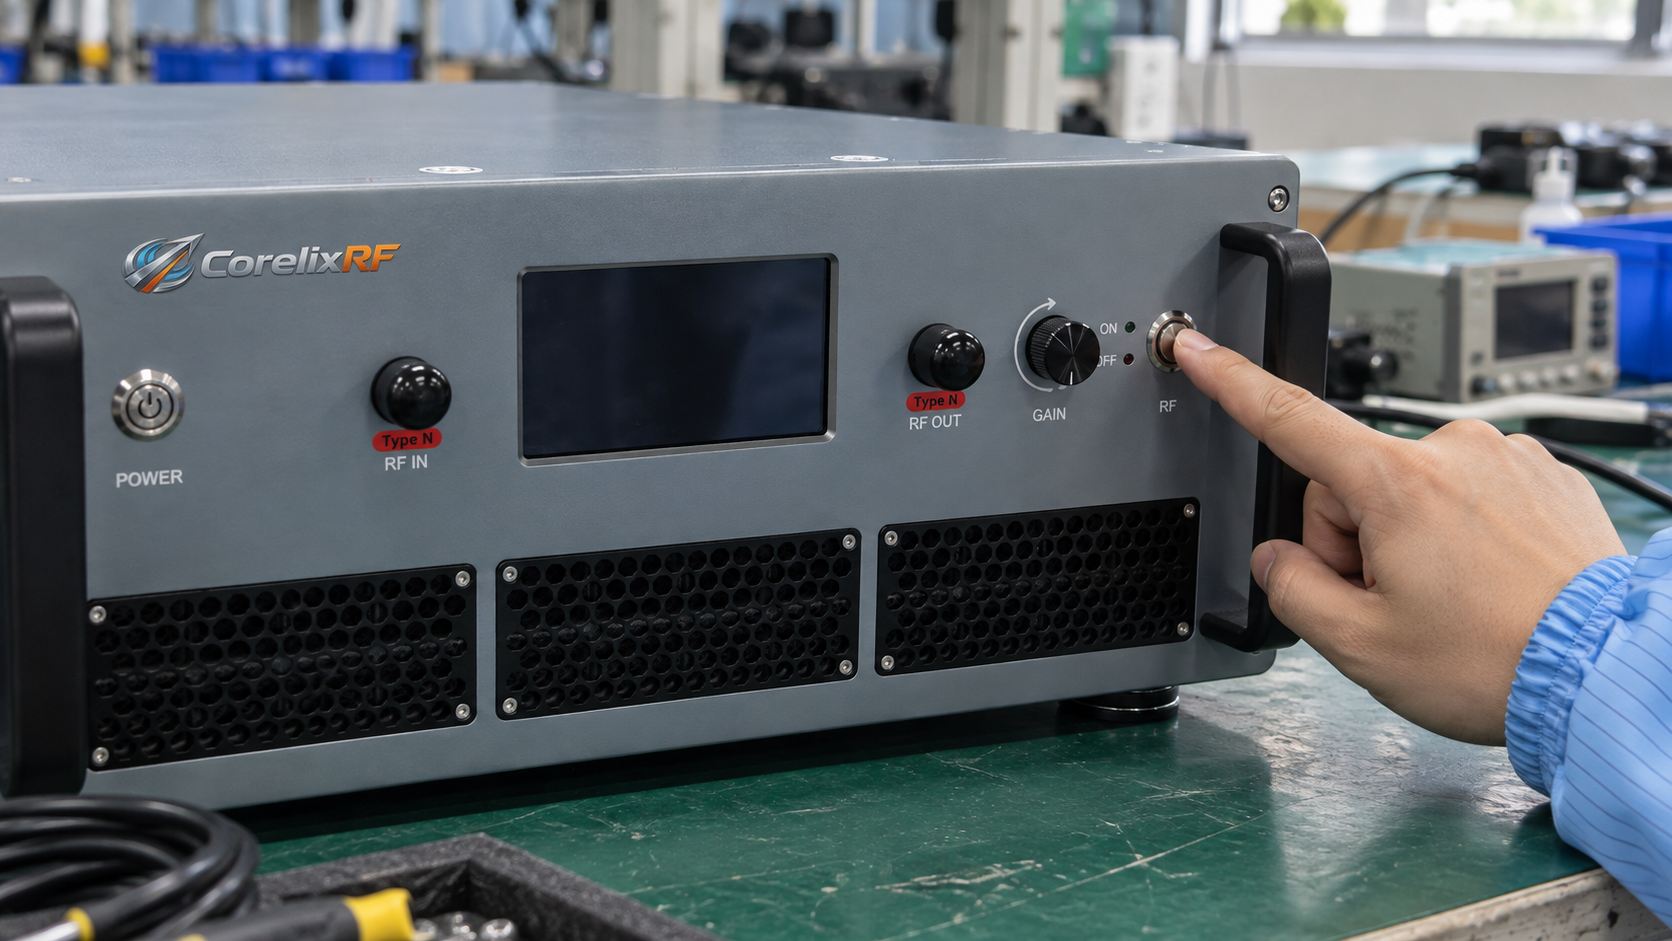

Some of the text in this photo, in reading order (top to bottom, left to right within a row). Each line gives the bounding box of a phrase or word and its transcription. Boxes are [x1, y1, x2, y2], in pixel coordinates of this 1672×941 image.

[200, 243, 401, 278] CorelixRF
[1100, 322, 1118, 335] ON
[914, 394, 958, 408] Type N
[1159, 400, 1177, 413] RF
[909, 414, 962, 430] RF OUT
[1032, 407, 1067, 422] GAIN
[382, 432, 434, 449] Type N
[385, 454, 428, 471] RF IN
[116, 469, 183, 488] POWER
